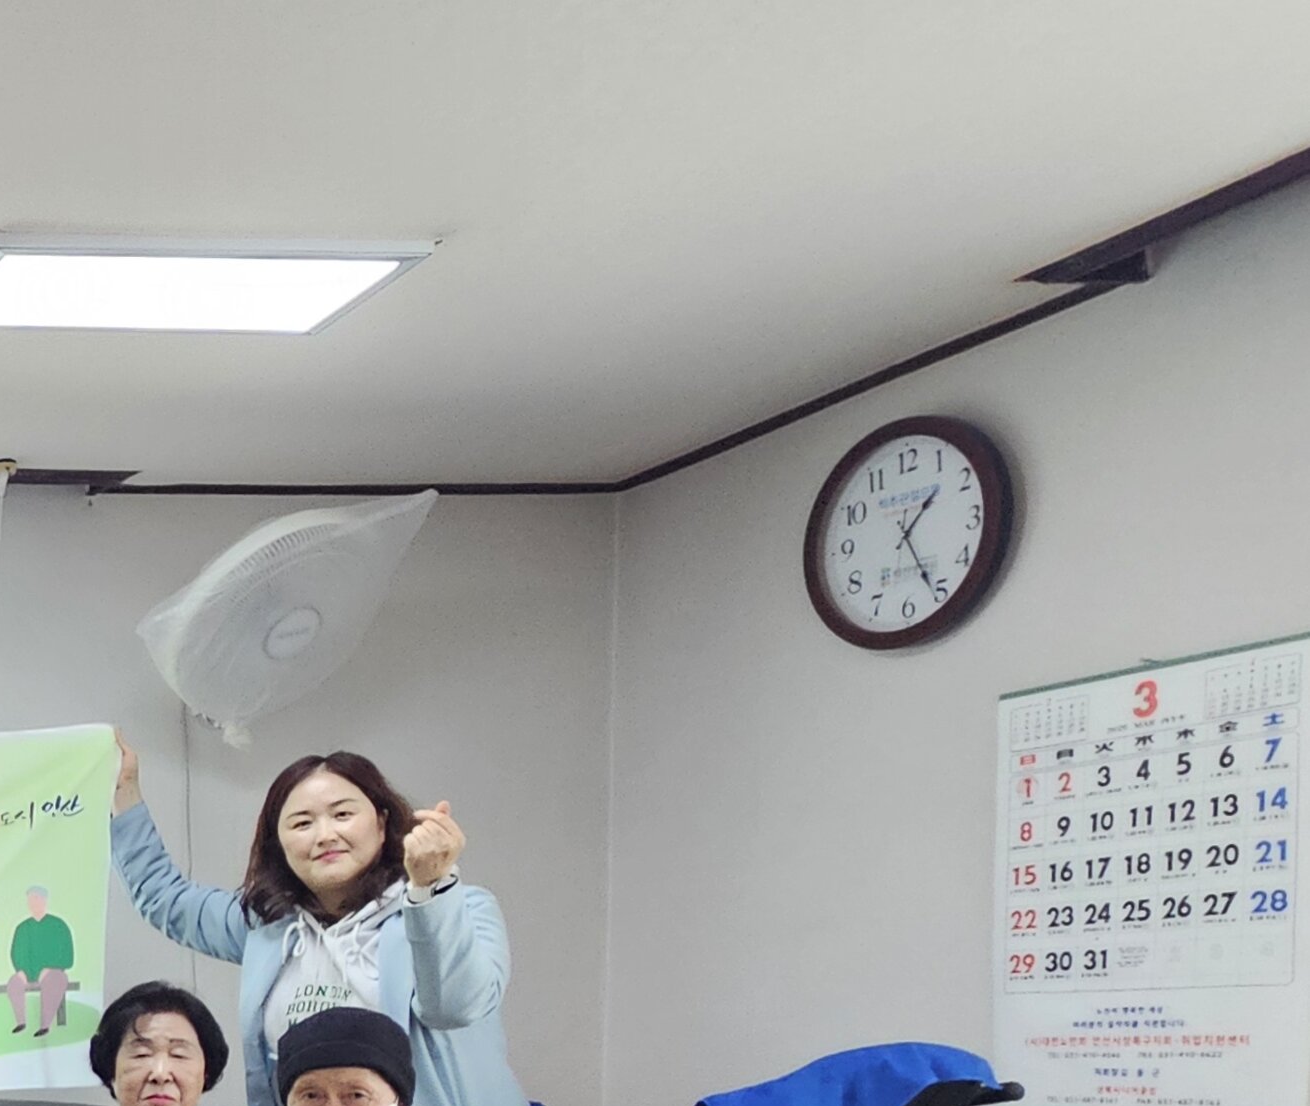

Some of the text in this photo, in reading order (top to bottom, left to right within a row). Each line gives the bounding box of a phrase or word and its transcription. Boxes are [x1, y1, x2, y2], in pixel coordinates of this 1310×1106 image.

[898, 449, 918, 474] 12
[936, 450, 943, 472] 1
[869, 469, 884, 492] 11
[959, 467, 971, 491] 2
[846, 502, 867, 526] 10
[966, 505, 980, 530] 3
[841, 539, 854, 562] 9
[955, 544, 970, 567] 4
[847, 571, 862, 594] 8
[934, 579, 948, 603] 5
[871, 594, 883, 616] 7
[902, 597, 915, 618] 6
[1133, 680, 1158, 718] 3
[1095, 743, 1113, 754] 火
[1263, 713, 1285, 727] 土
[1024, 738, 1281, 798] 1 2 3 4 5 6 7
[41, 795, 84, 817] 안산
[1020, 787, 1288, 842] 8 9 10 11 12 13 14
[1013, 839, 1287, 886] 15 16 17 18 19 20 21
[1011, 889, 1288, 930] 22 23 24 25 26 27 28
[1009, 953, 1035, 974] 29
[1044, 951, 1073, 973] 30
[1083, 949, 1108, 971] 31
